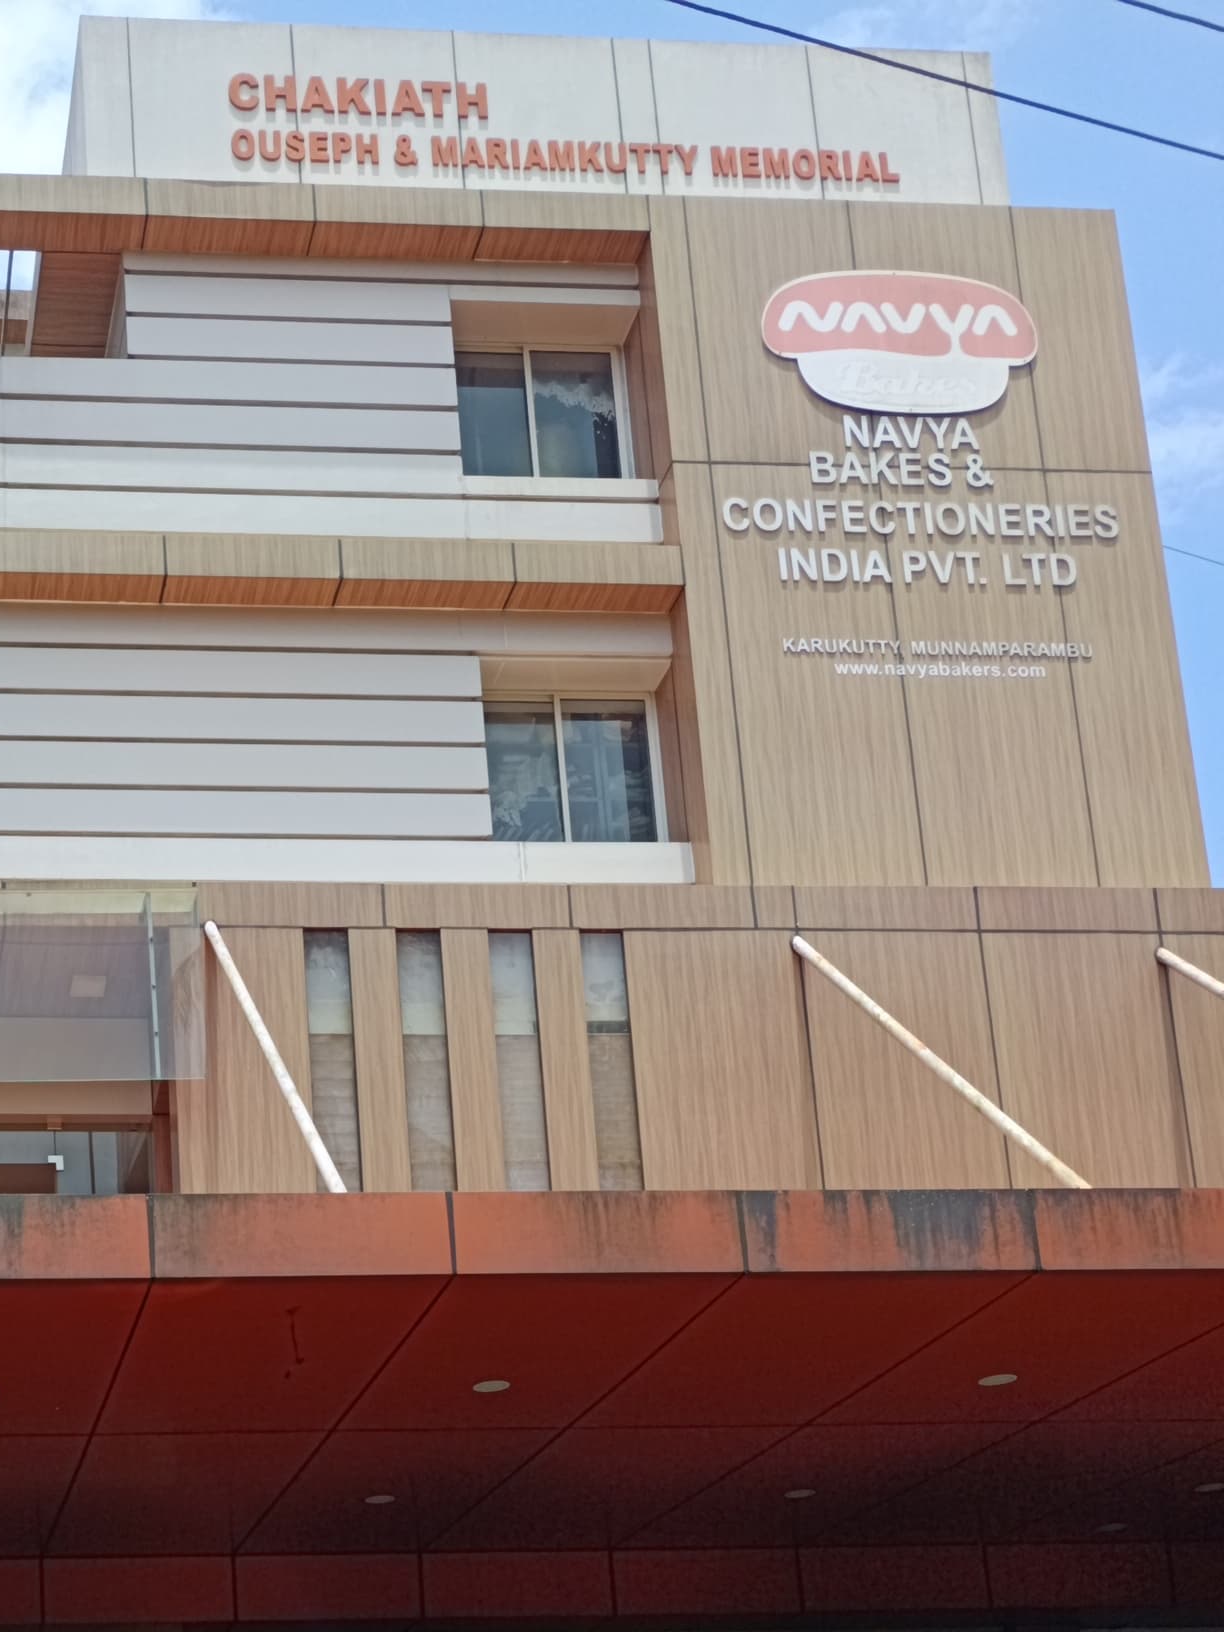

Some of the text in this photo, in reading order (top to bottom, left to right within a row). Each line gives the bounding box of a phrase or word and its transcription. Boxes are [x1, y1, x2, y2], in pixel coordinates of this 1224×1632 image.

[228, 73, 488, 119] CHAKIATH
[231, 129, 900, 183] OUSEPH & MARIAMKUTTY MEMORIAL
[779, 300, 1018, 346] NAVYA
[838, 359, 977, 397] Bakes
[843, 415, 979, 450] NAVYA
[809, 451, 994, 488] BAKES &
[722, 498, 1119, 539] CONFECTIONERIES
[778, 547, 1077, 587] INDIA PVT. LTD
[911, 641, 1093, 659] MUNNAMPARAMBU
[834, 662, 1046, 679] www.navyabakers.com
